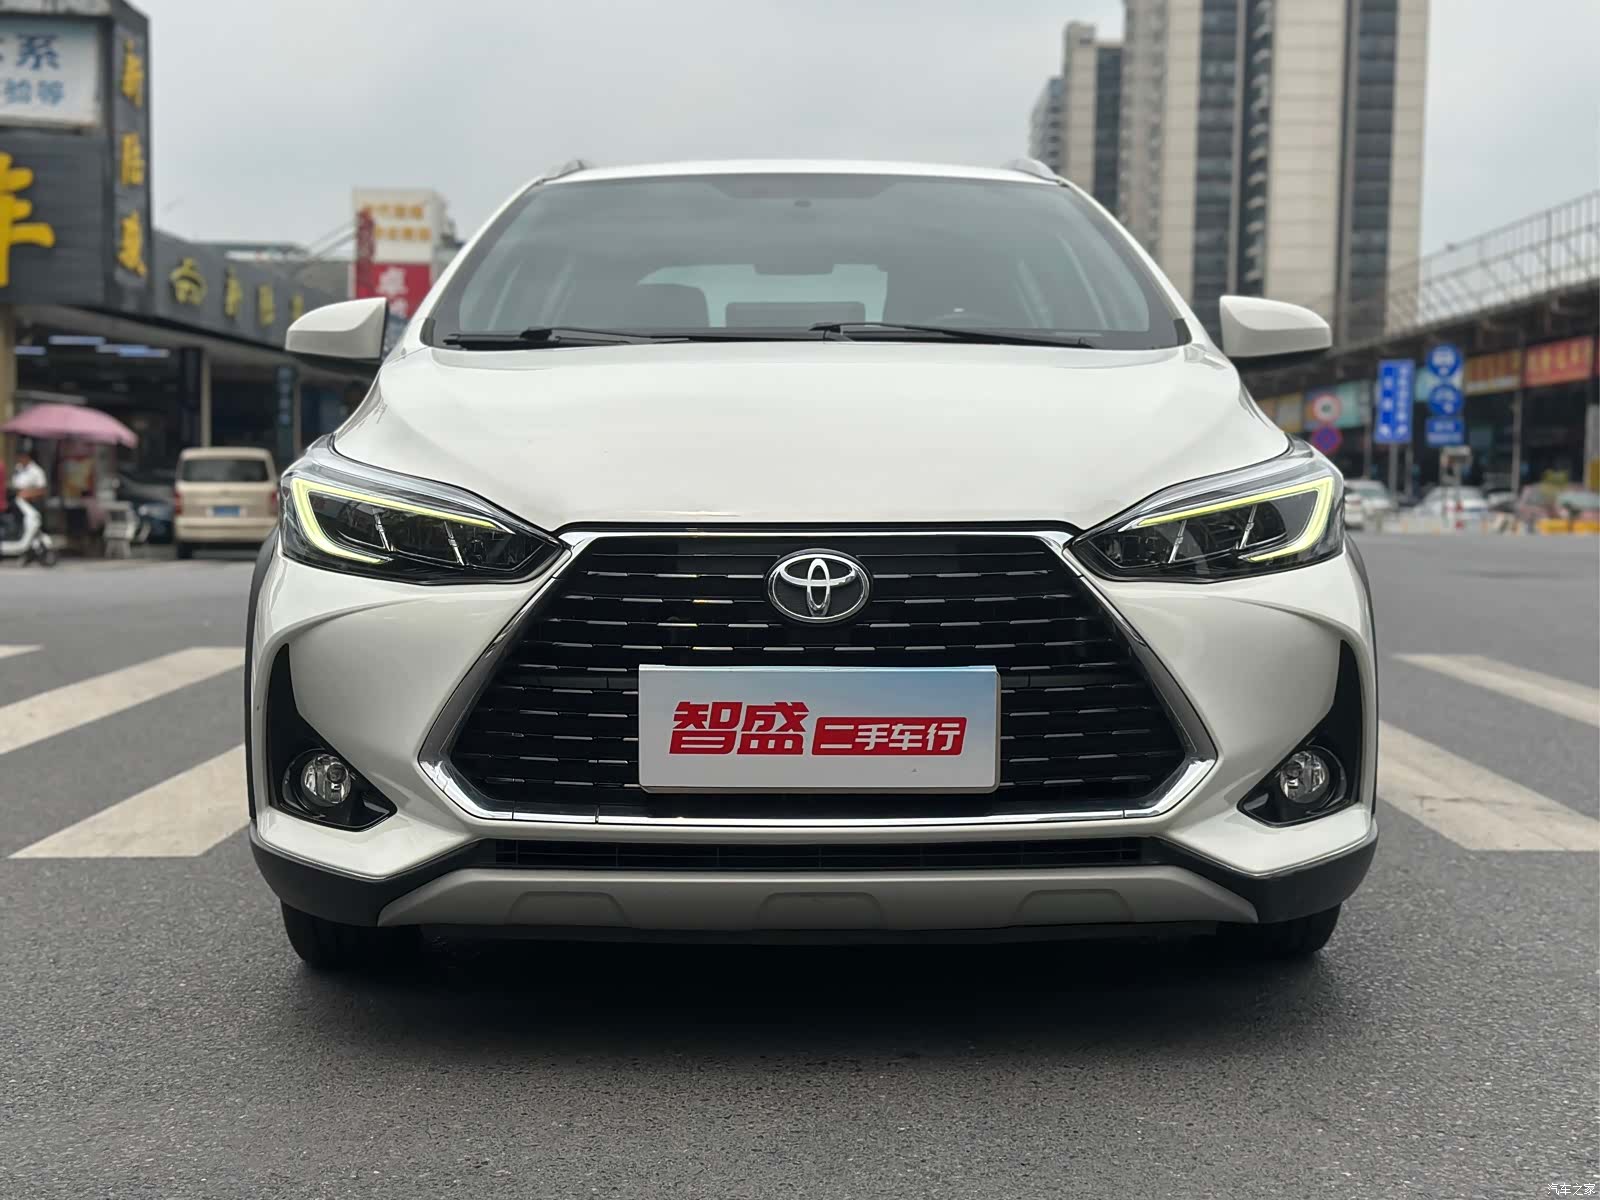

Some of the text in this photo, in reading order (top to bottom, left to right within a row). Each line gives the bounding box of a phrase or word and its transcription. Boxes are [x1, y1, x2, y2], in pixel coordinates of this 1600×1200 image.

[669, 701, 961, 756] 智盛 二手车行
